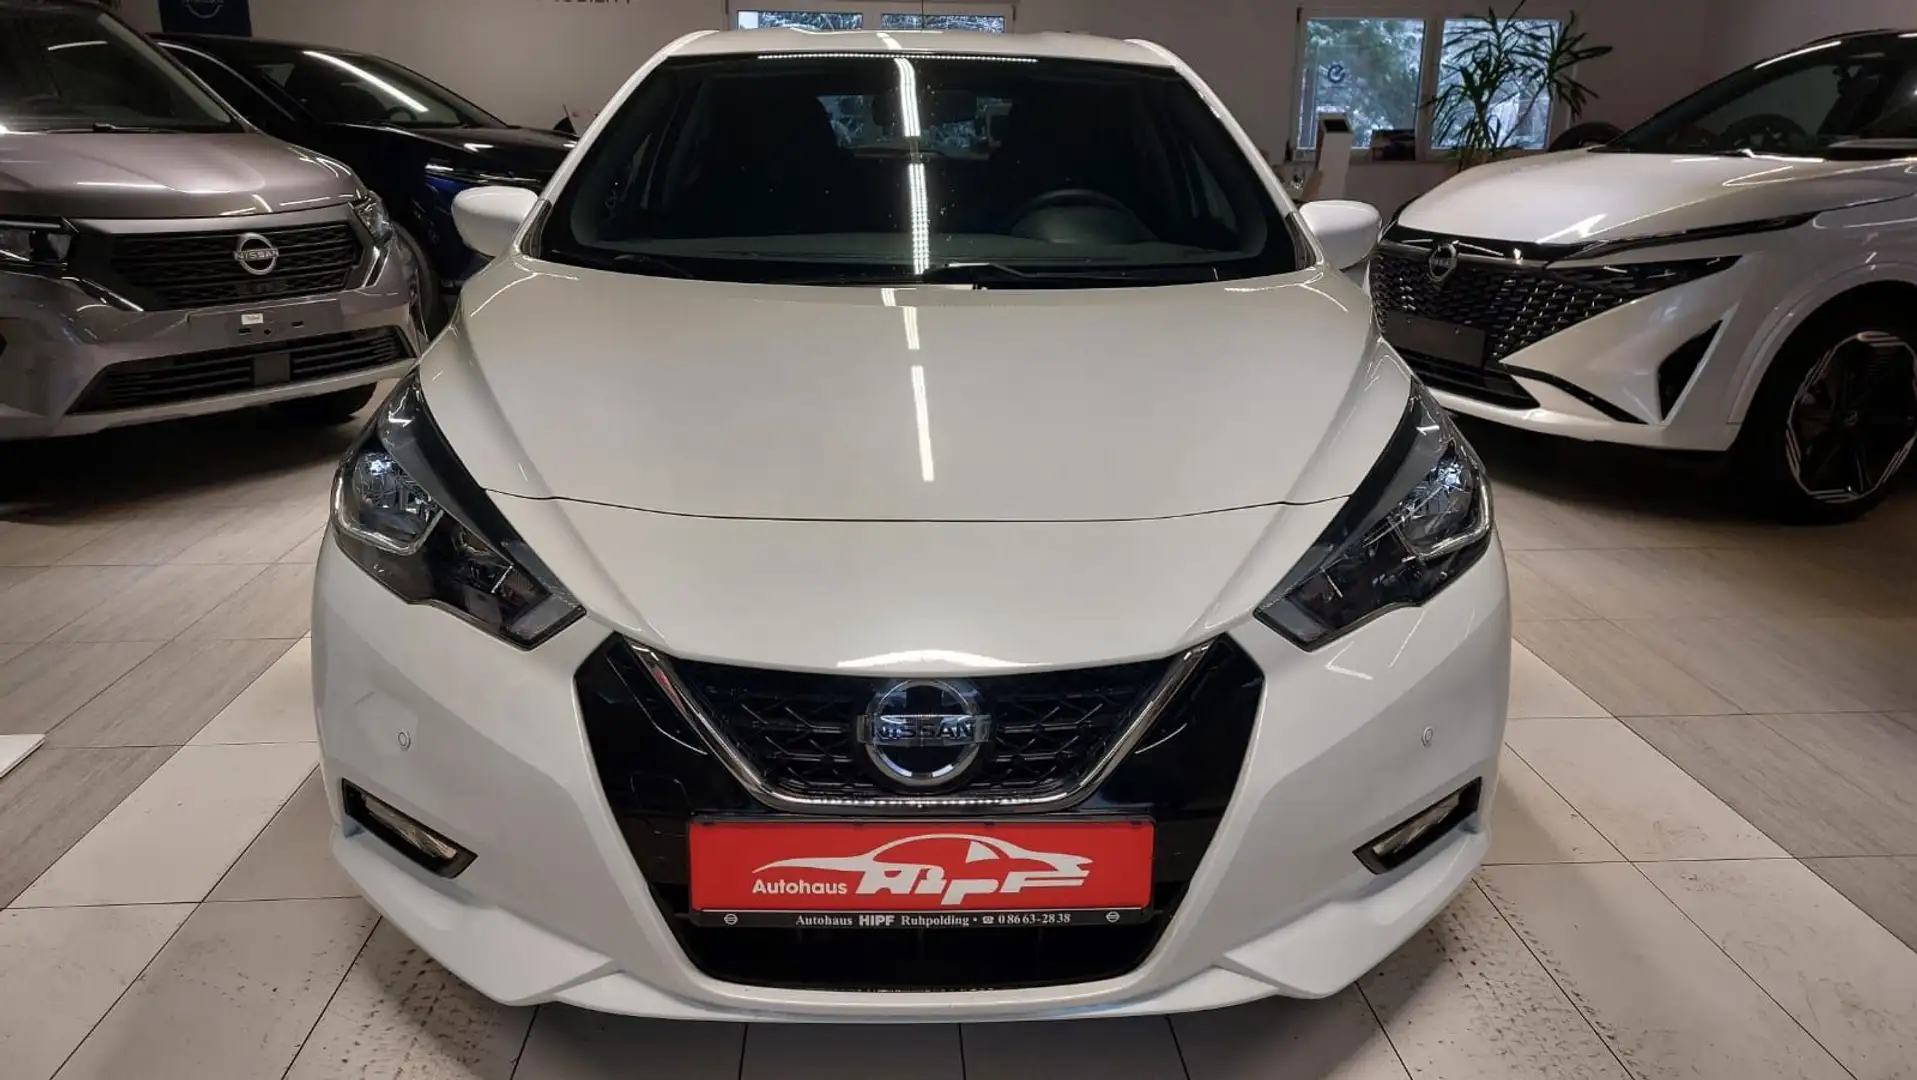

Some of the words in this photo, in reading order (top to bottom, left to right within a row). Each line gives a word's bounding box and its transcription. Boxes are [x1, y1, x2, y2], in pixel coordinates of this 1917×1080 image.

[752, 879, 848, 894] Autohaus
[796, 914, 853, 926] Autohaus
[859, 914, 895, 926] HIPF
[901, 914, 969, 928] Ruhpolding
